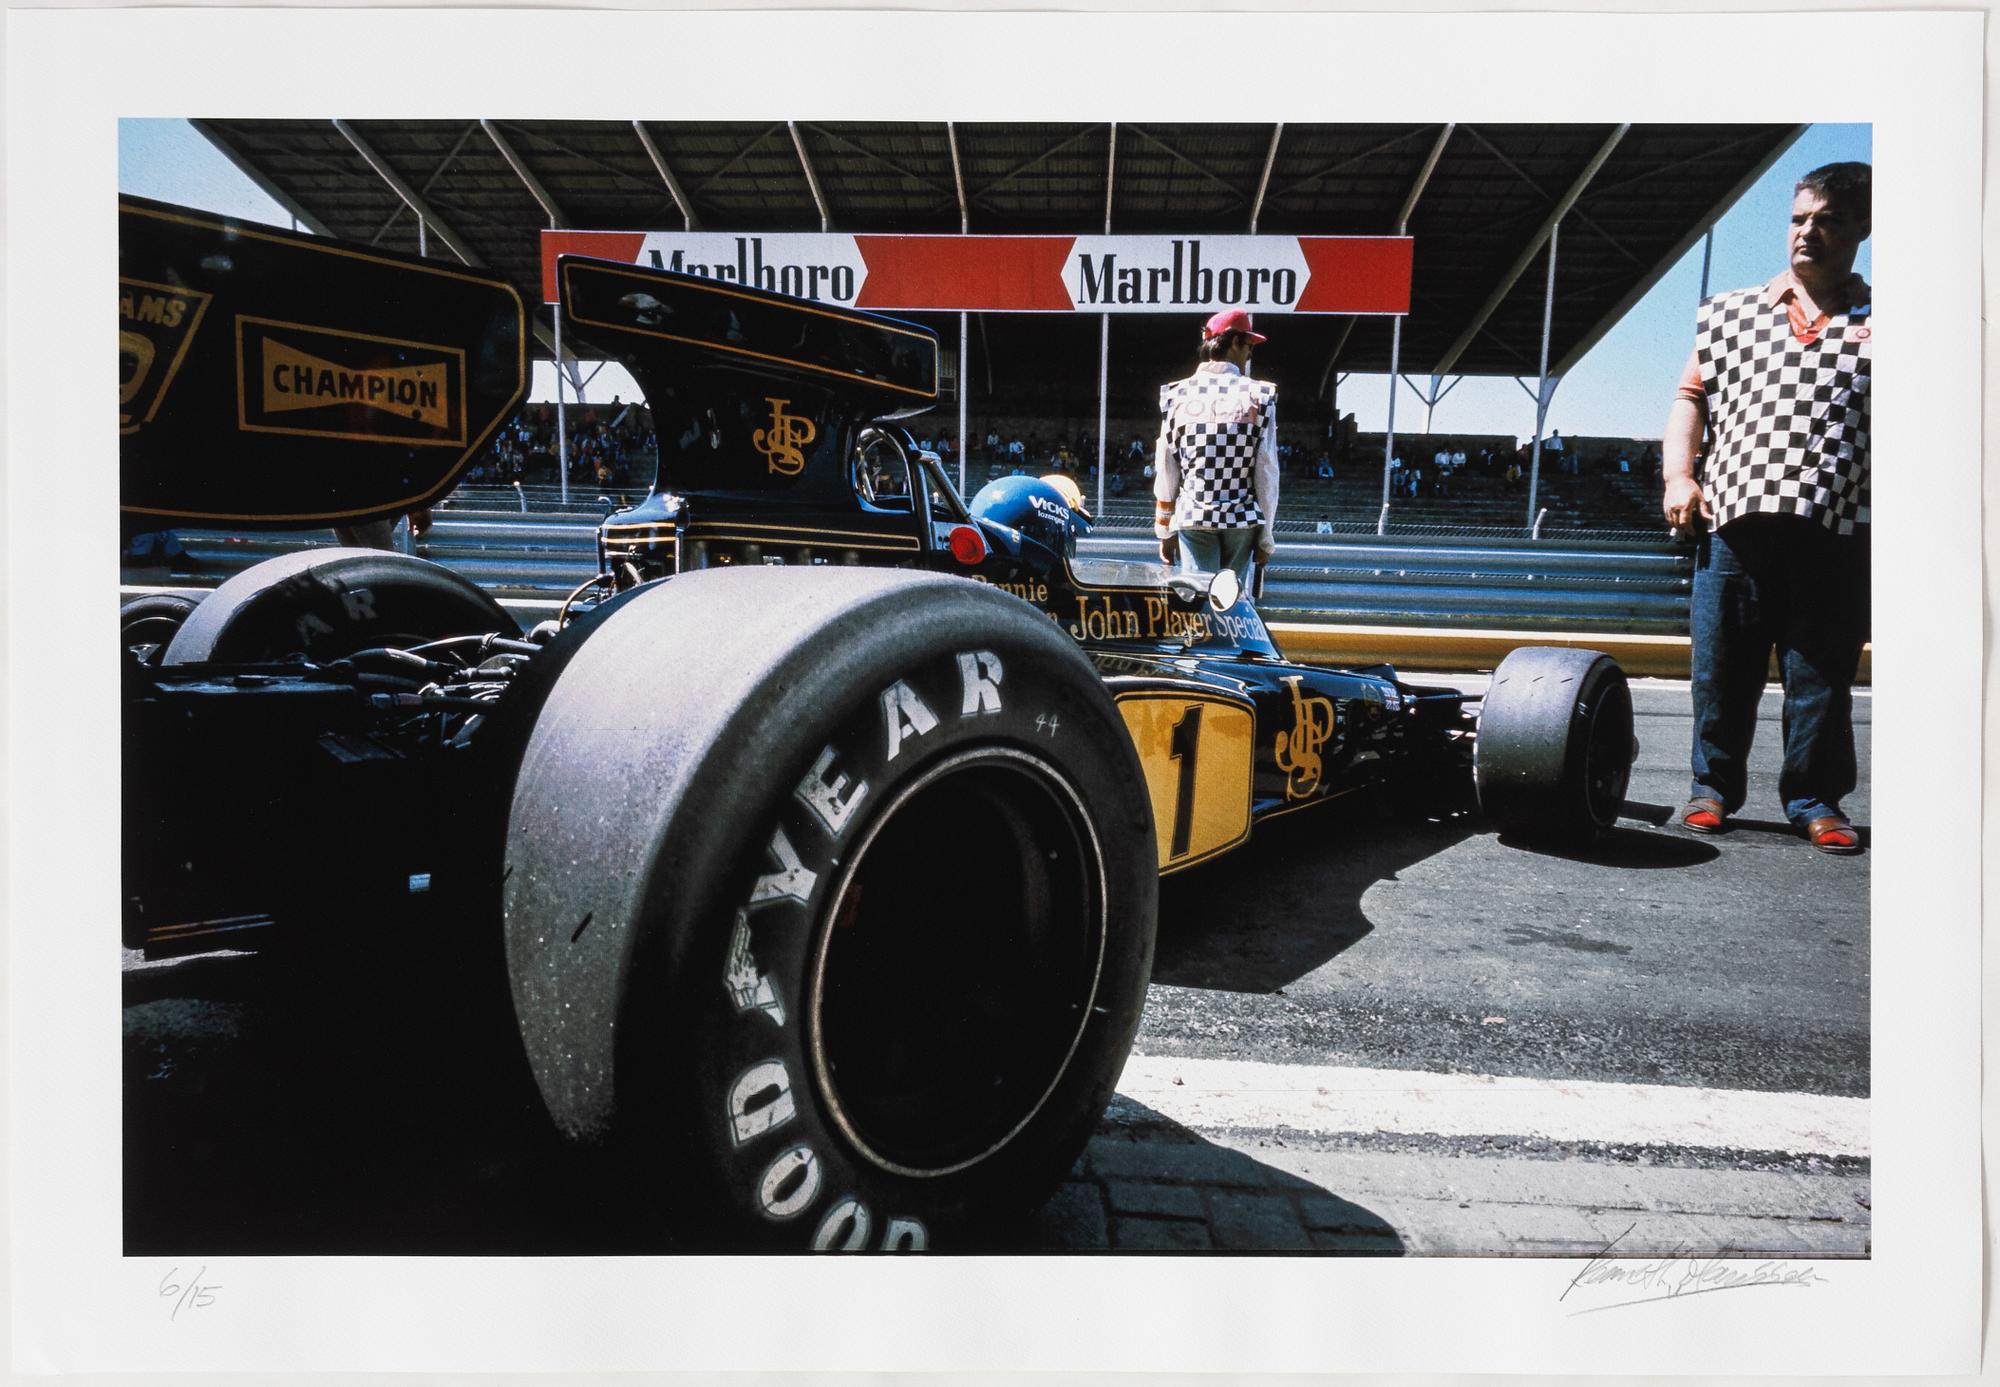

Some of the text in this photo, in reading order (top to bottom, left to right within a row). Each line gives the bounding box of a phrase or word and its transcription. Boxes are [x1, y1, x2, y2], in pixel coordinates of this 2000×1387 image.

[1077, 240, 1297, 305] Marlboro
[272, 363, 438, 409] CHAMPION
[1028, 495, 1070, 520] VICKS
[971, 574, 1048, 602] nnie
[1070, 595, 1140, 641] John
[1144, 596, 1213, 648] Player
[1169, 703, 1204, 861] 1
[159, 1265, 223, 1321] 6/15
